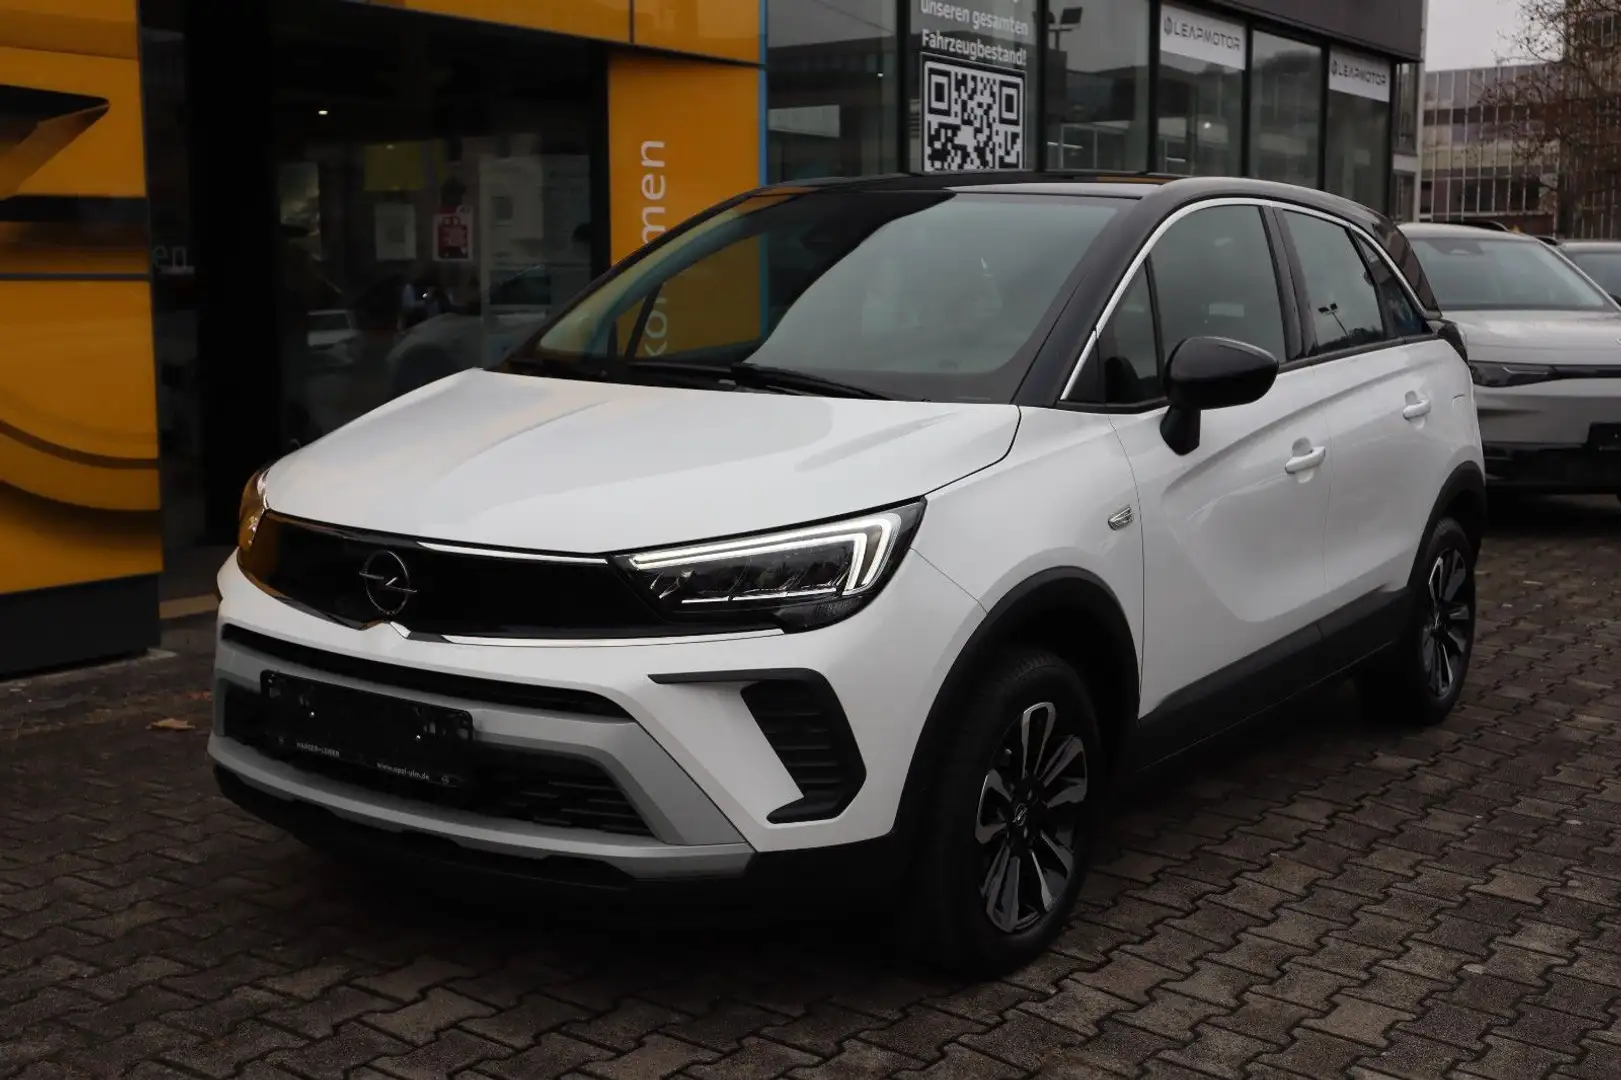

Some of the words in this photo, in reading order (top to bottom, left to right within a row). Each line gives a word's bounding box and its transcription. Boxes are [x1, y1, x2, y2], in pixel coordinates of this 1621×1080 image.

[972, 10, 1029, 36] gesamten
[1173, 21, 1241, 51] LEAPMOTOR
[921, 28, 1027, 66] Fahrzeugbestand!
